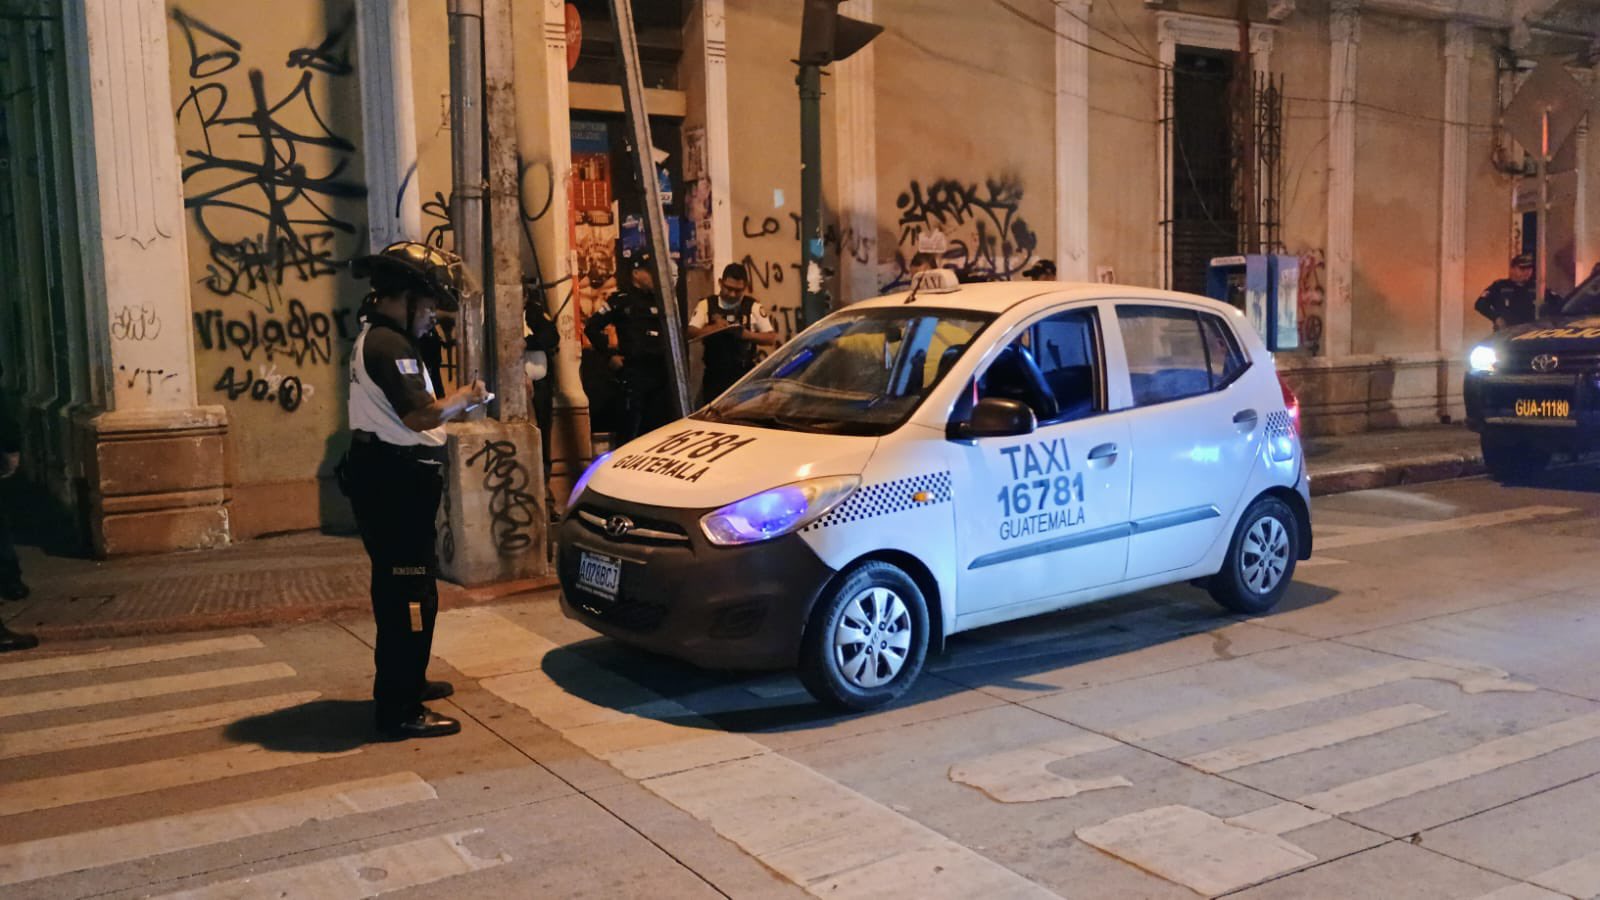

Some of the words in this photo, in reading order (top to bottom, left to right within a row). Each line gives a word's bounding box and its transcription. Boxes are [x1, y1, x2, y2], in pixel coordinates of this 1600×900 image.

[1515, 399, 1569, 417] GUA-11180
[644, 429, 757, 463] 16781
[1000, 438, 1070, 480] TAXI
[612, 455, 710, 483] GUATEMALA
[997, 472, 1084, 517] 16781
[1000, 506, 1085, 540] GUATEMALA
